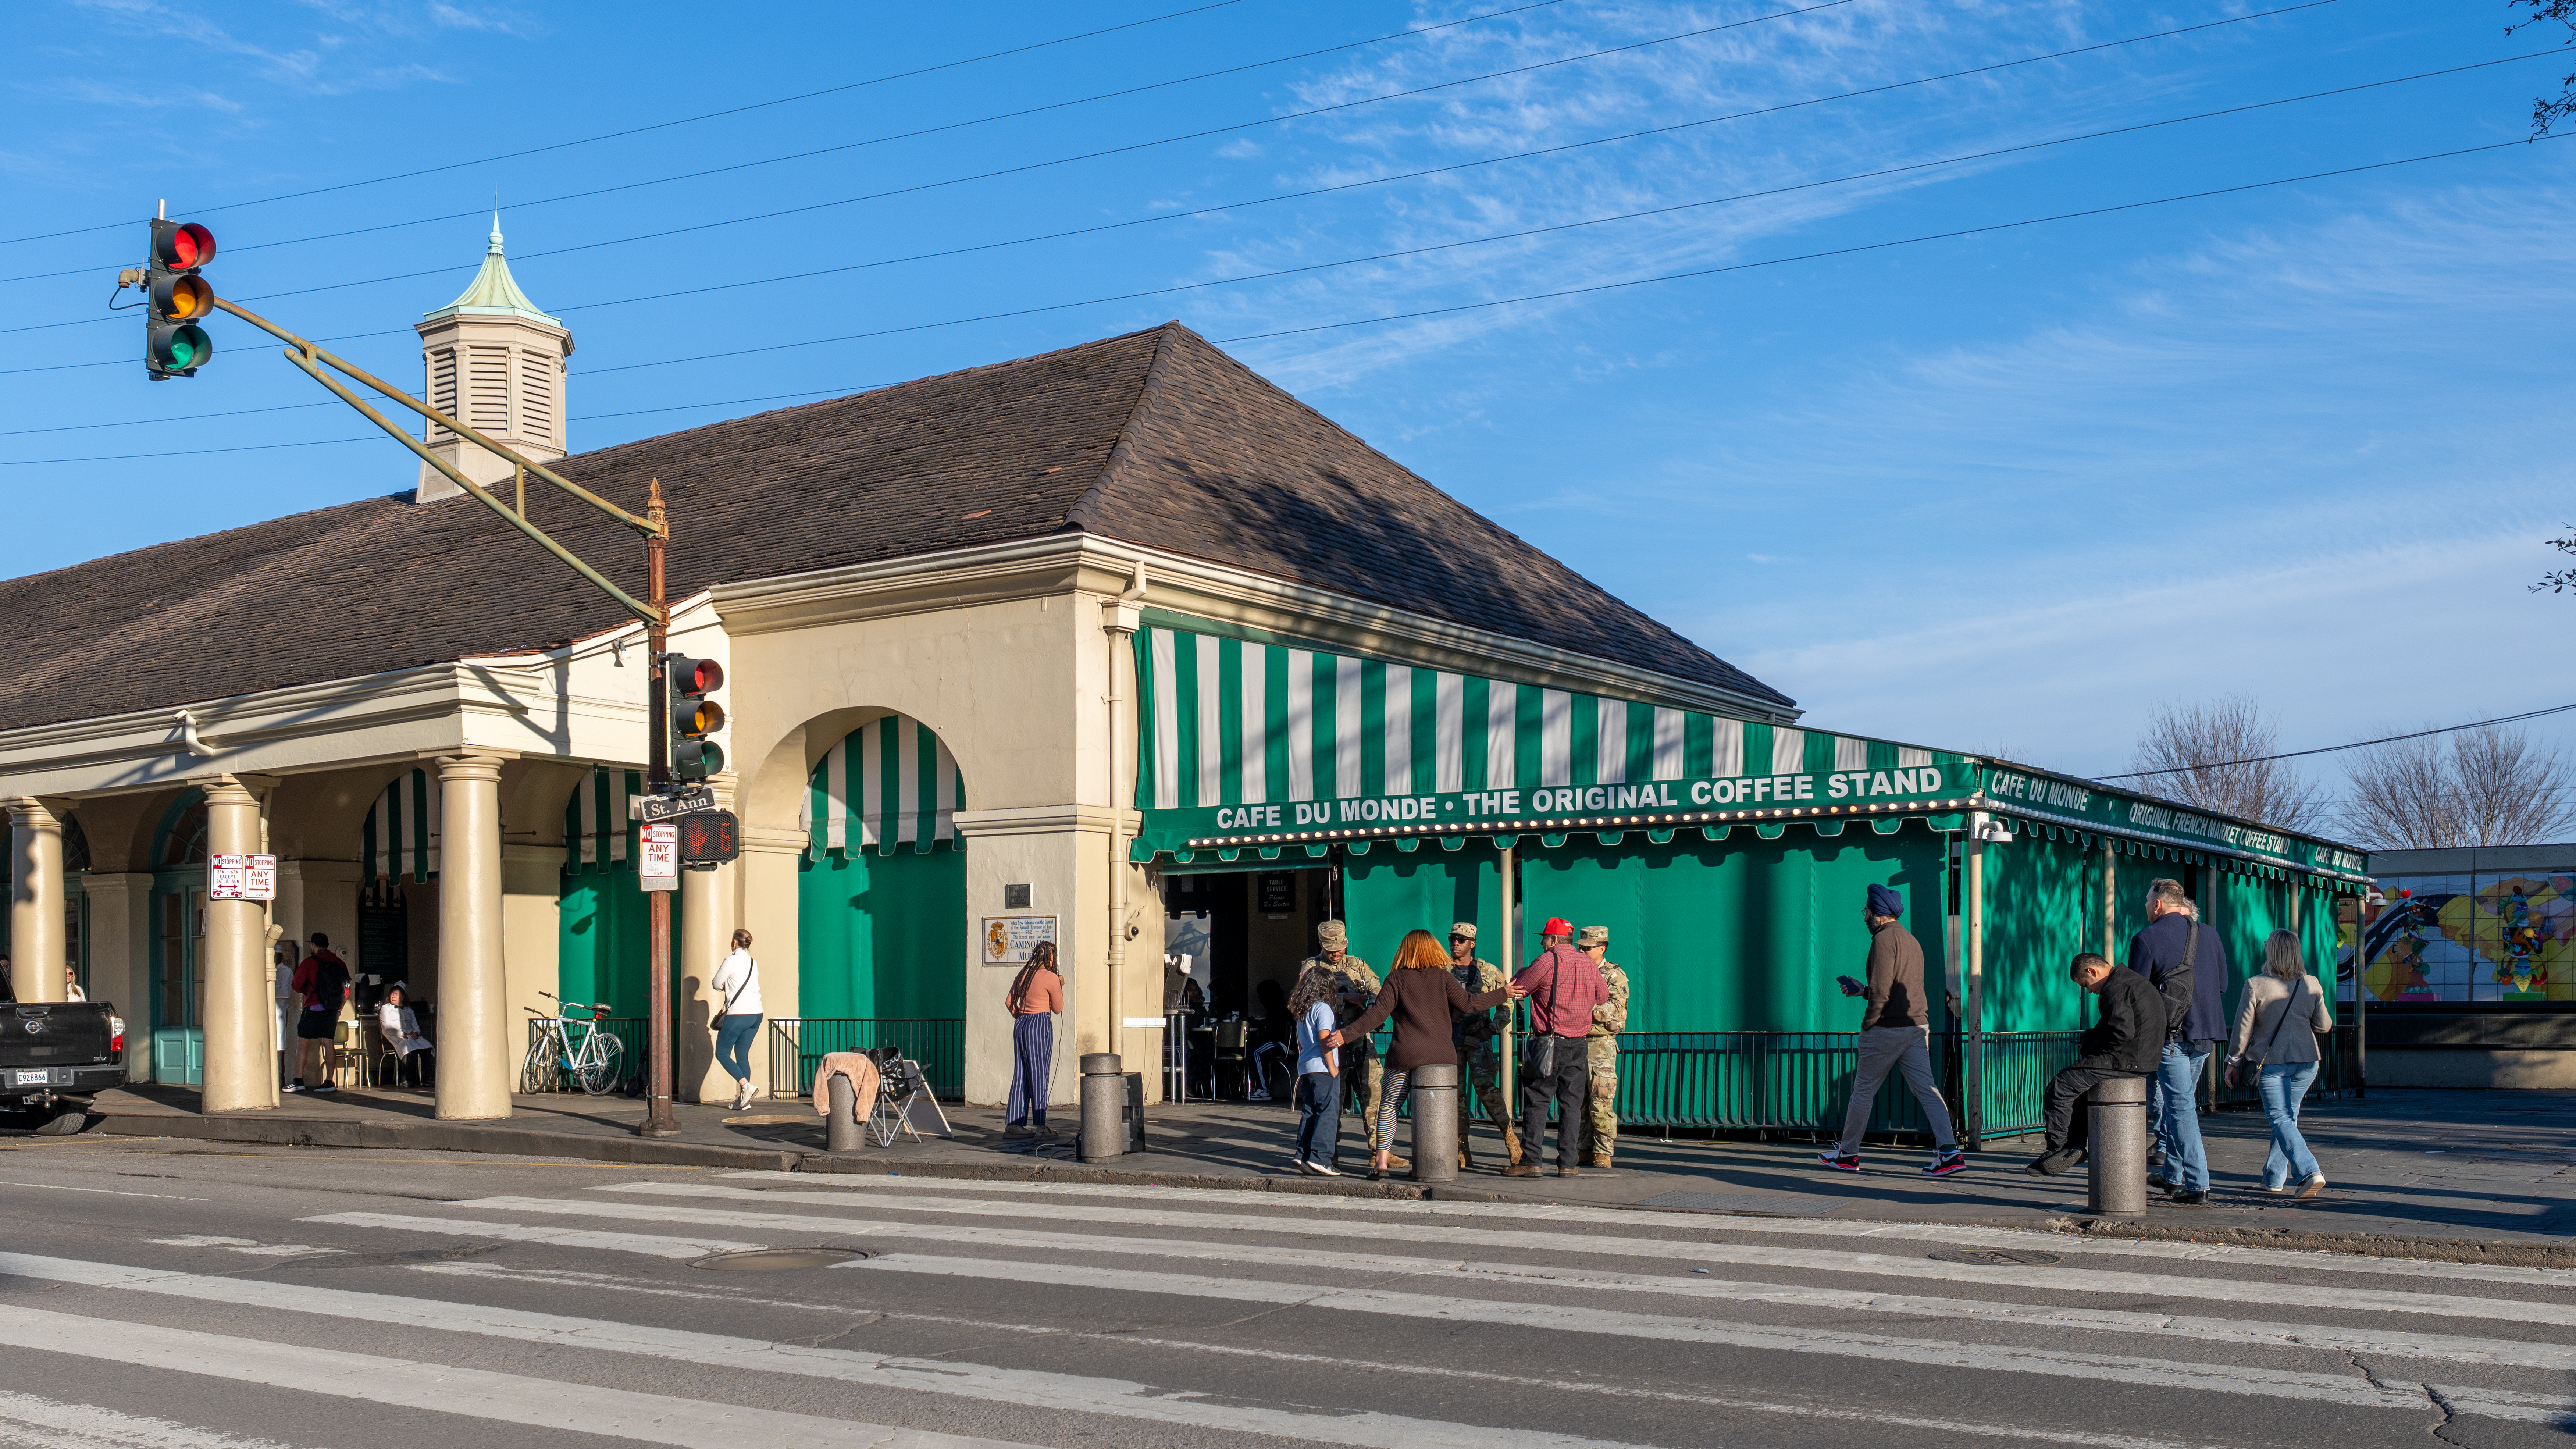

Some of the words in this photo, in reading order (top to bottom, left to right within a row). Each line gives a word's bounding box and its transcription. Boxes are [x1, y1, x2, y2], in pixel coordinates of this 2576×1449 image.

[1217, 805, 1281, 829] CAFE
[1296, 802, 1330, 825] DU
[1340, 797, 1436, 822] MONDE
[1463, 791, 1520, 816] THE
[1532, 783, 1678, 812] ORIGINAL
[1691, 775, 1814, 805] COFFEE
[1828, 767, 1942, 798] STAND
[651, 803, 670, 816] St.
[677, 797, 709, 812] Ann
[1991, 769, 2026, 798] CAFE
[2029, 777, 2048, 802] DU
[2047, 782, 2089, 811] MONDE
[2129, 802, 2173, 830] ORIGINAL
[2172, 811, 2208, 837] FRENCH
[2208, 818, 2241, 844] MARKET
[2240, 828, 2268, 850] COFFEE
[2267, 835, 2290, 854] STAND
[642, 828, 652, 839] NO
[648, 844, 669, 853] ANY
[213, 857, 222, 866] NO
[245, 857, 254, 866] NO
[648, 854, 669, 862] TIME
[2315, 845, 2331, 864] CAFE
[2332, 850, 2342, 867] DU
[2342, 852, 2363, 871] MONDE
[1010, 940, 1036, 949] CAMINO
[19, 1074, 46, 1082] C928866
